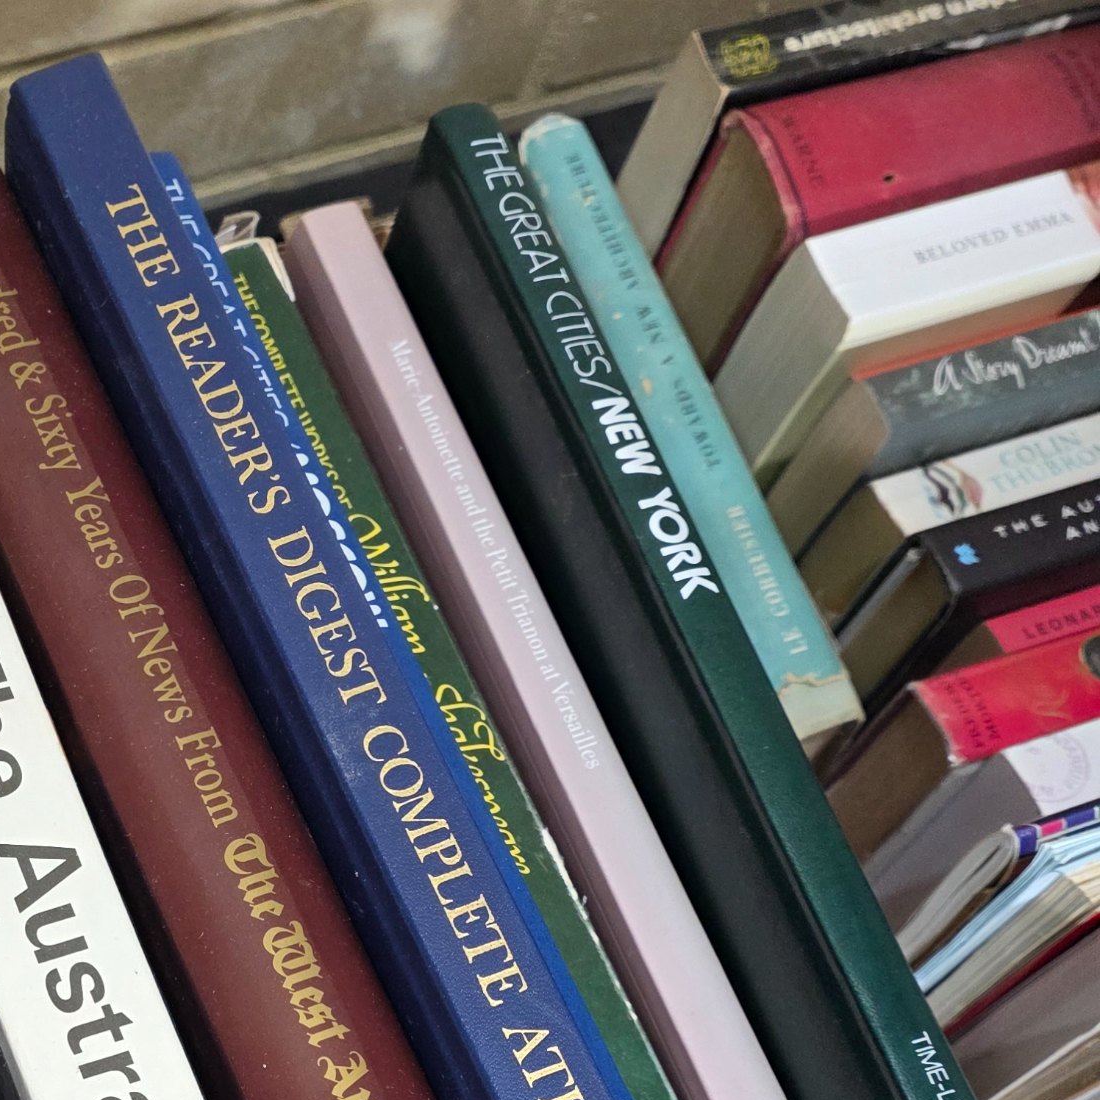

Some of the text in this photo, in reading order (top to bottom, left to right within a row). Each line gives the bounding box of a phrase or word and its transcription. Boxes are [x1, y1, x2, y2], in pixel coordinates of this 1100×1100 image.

[913, 209, 1076, 265] BELOVED EMMA
[9, 360, 47, 389] &
[469, 131, 525, 191] THE
[498, 190, 570, 287] GREAT
[638, 486, 720, 600] YORK
[25, 394, 81, 471] Sixty
[991, 445, 1100, 493] THUBRO
[65, 476, 124, 569] Years
[455, 480, 487, 517] and
[471, 517, 496, 547] the
[993, 513, 1049, 538] THE
[105, 183, 180, 288] THE
[156, 293, 291, 514] READER'S
[267, 525, 387, 705] DIGEST
[361, 724, 529, 1007] COMPLETE
[109, 574, 164, 620] Of
[485, 547, 517, 590] Petit
[506, 589, 548, 662] Trianon
[128, 622, 192, 724] News
[540, 664, 562, 681] at
[550, 680, 600, 770] Versailles
[175, 726, 239, 829] From
[223, 832, 285, 922] The
[262, 920, 349, 1048] West
